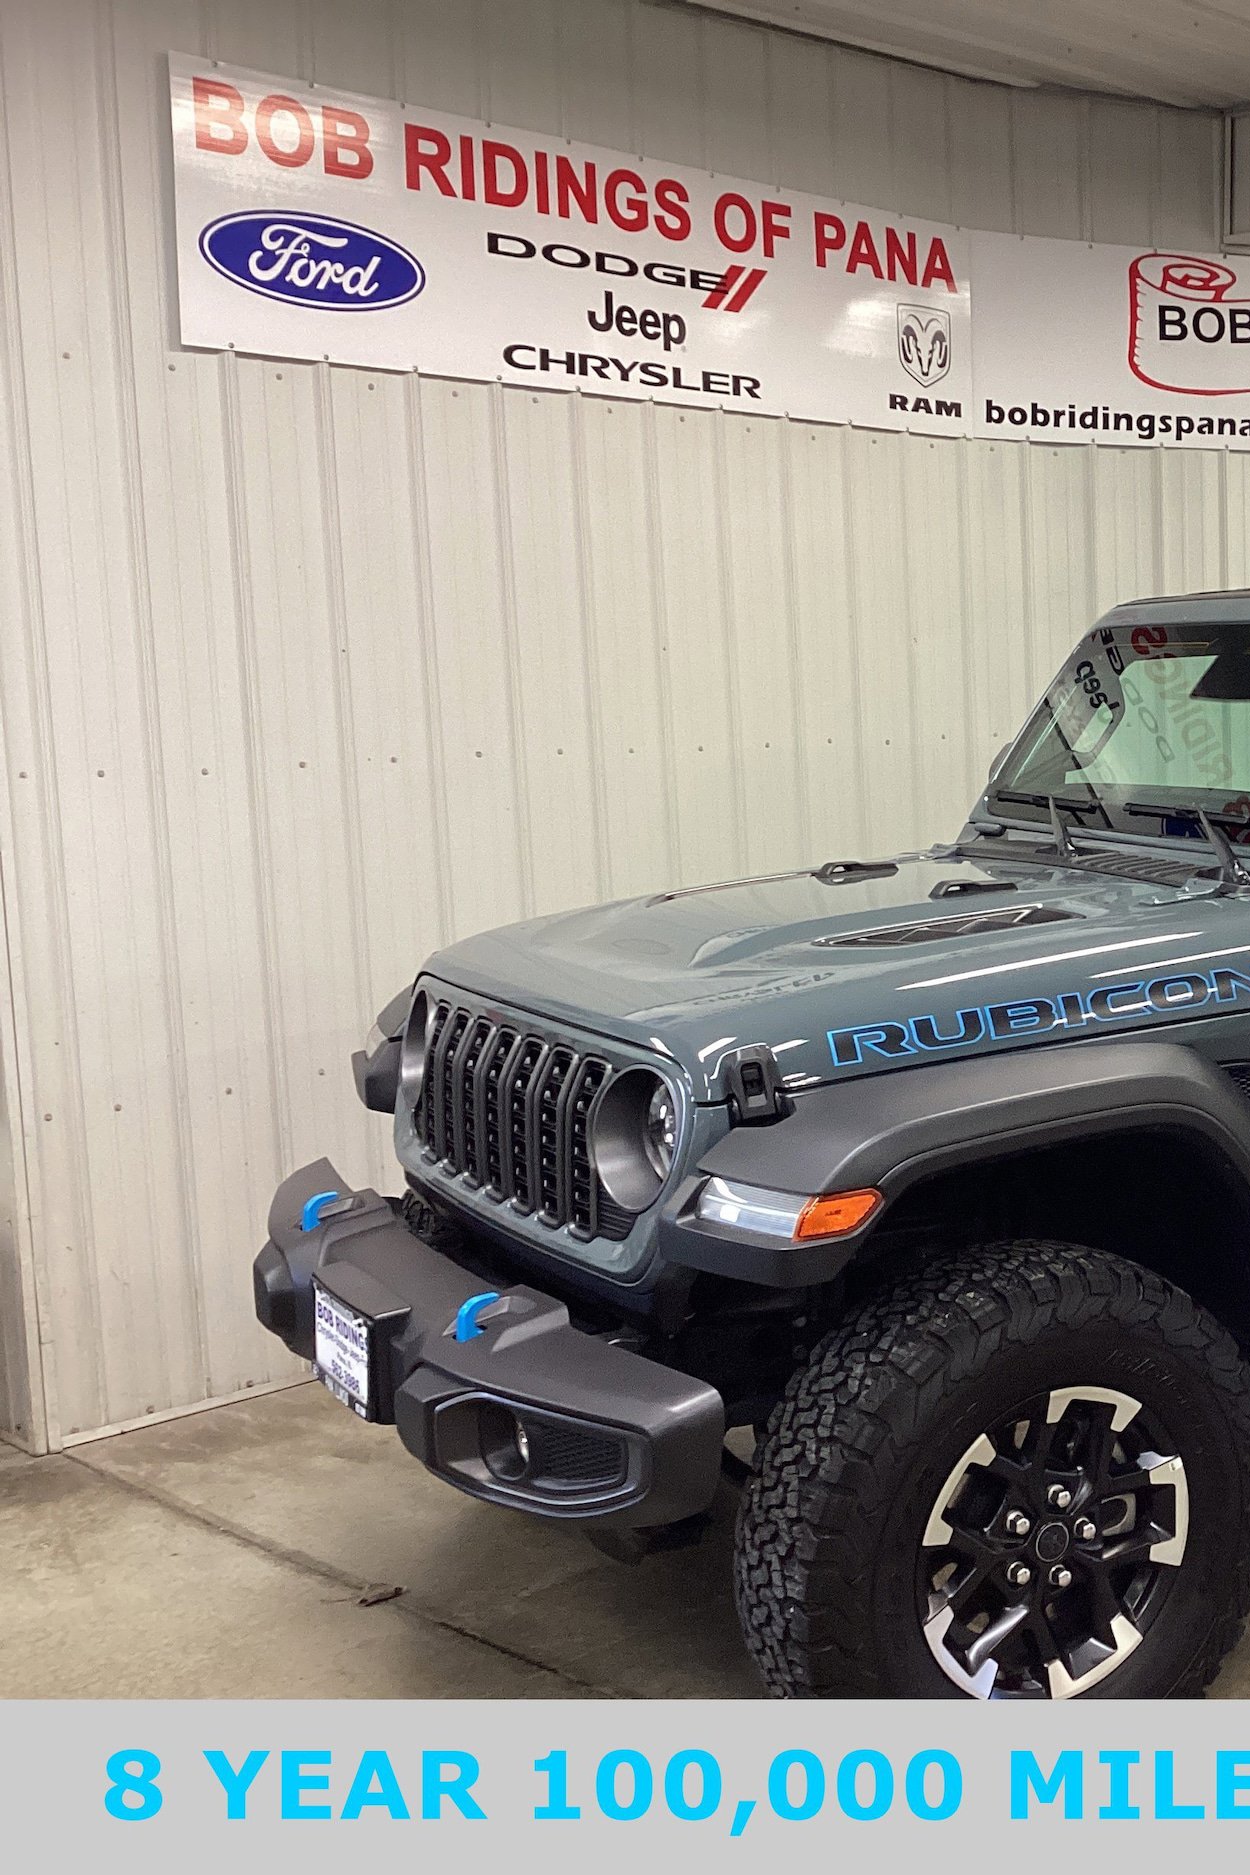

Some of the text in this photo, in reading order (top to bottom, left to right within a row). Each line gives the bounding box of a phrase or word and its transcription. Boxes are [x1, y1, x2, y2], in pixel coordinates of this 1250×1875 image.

[191, 76, 958, 294] BOB RIDINGS OF PANA
[247, 223, 381, 297] Ford
[487, 231, 730, 296] DODGE
[587, 290, 687, 352] Jeep
[503, 344, 761, 399] CHRYSLER
[889, 393, 962, 419] RAM
[317, 1300, 335, 1328] BOB
